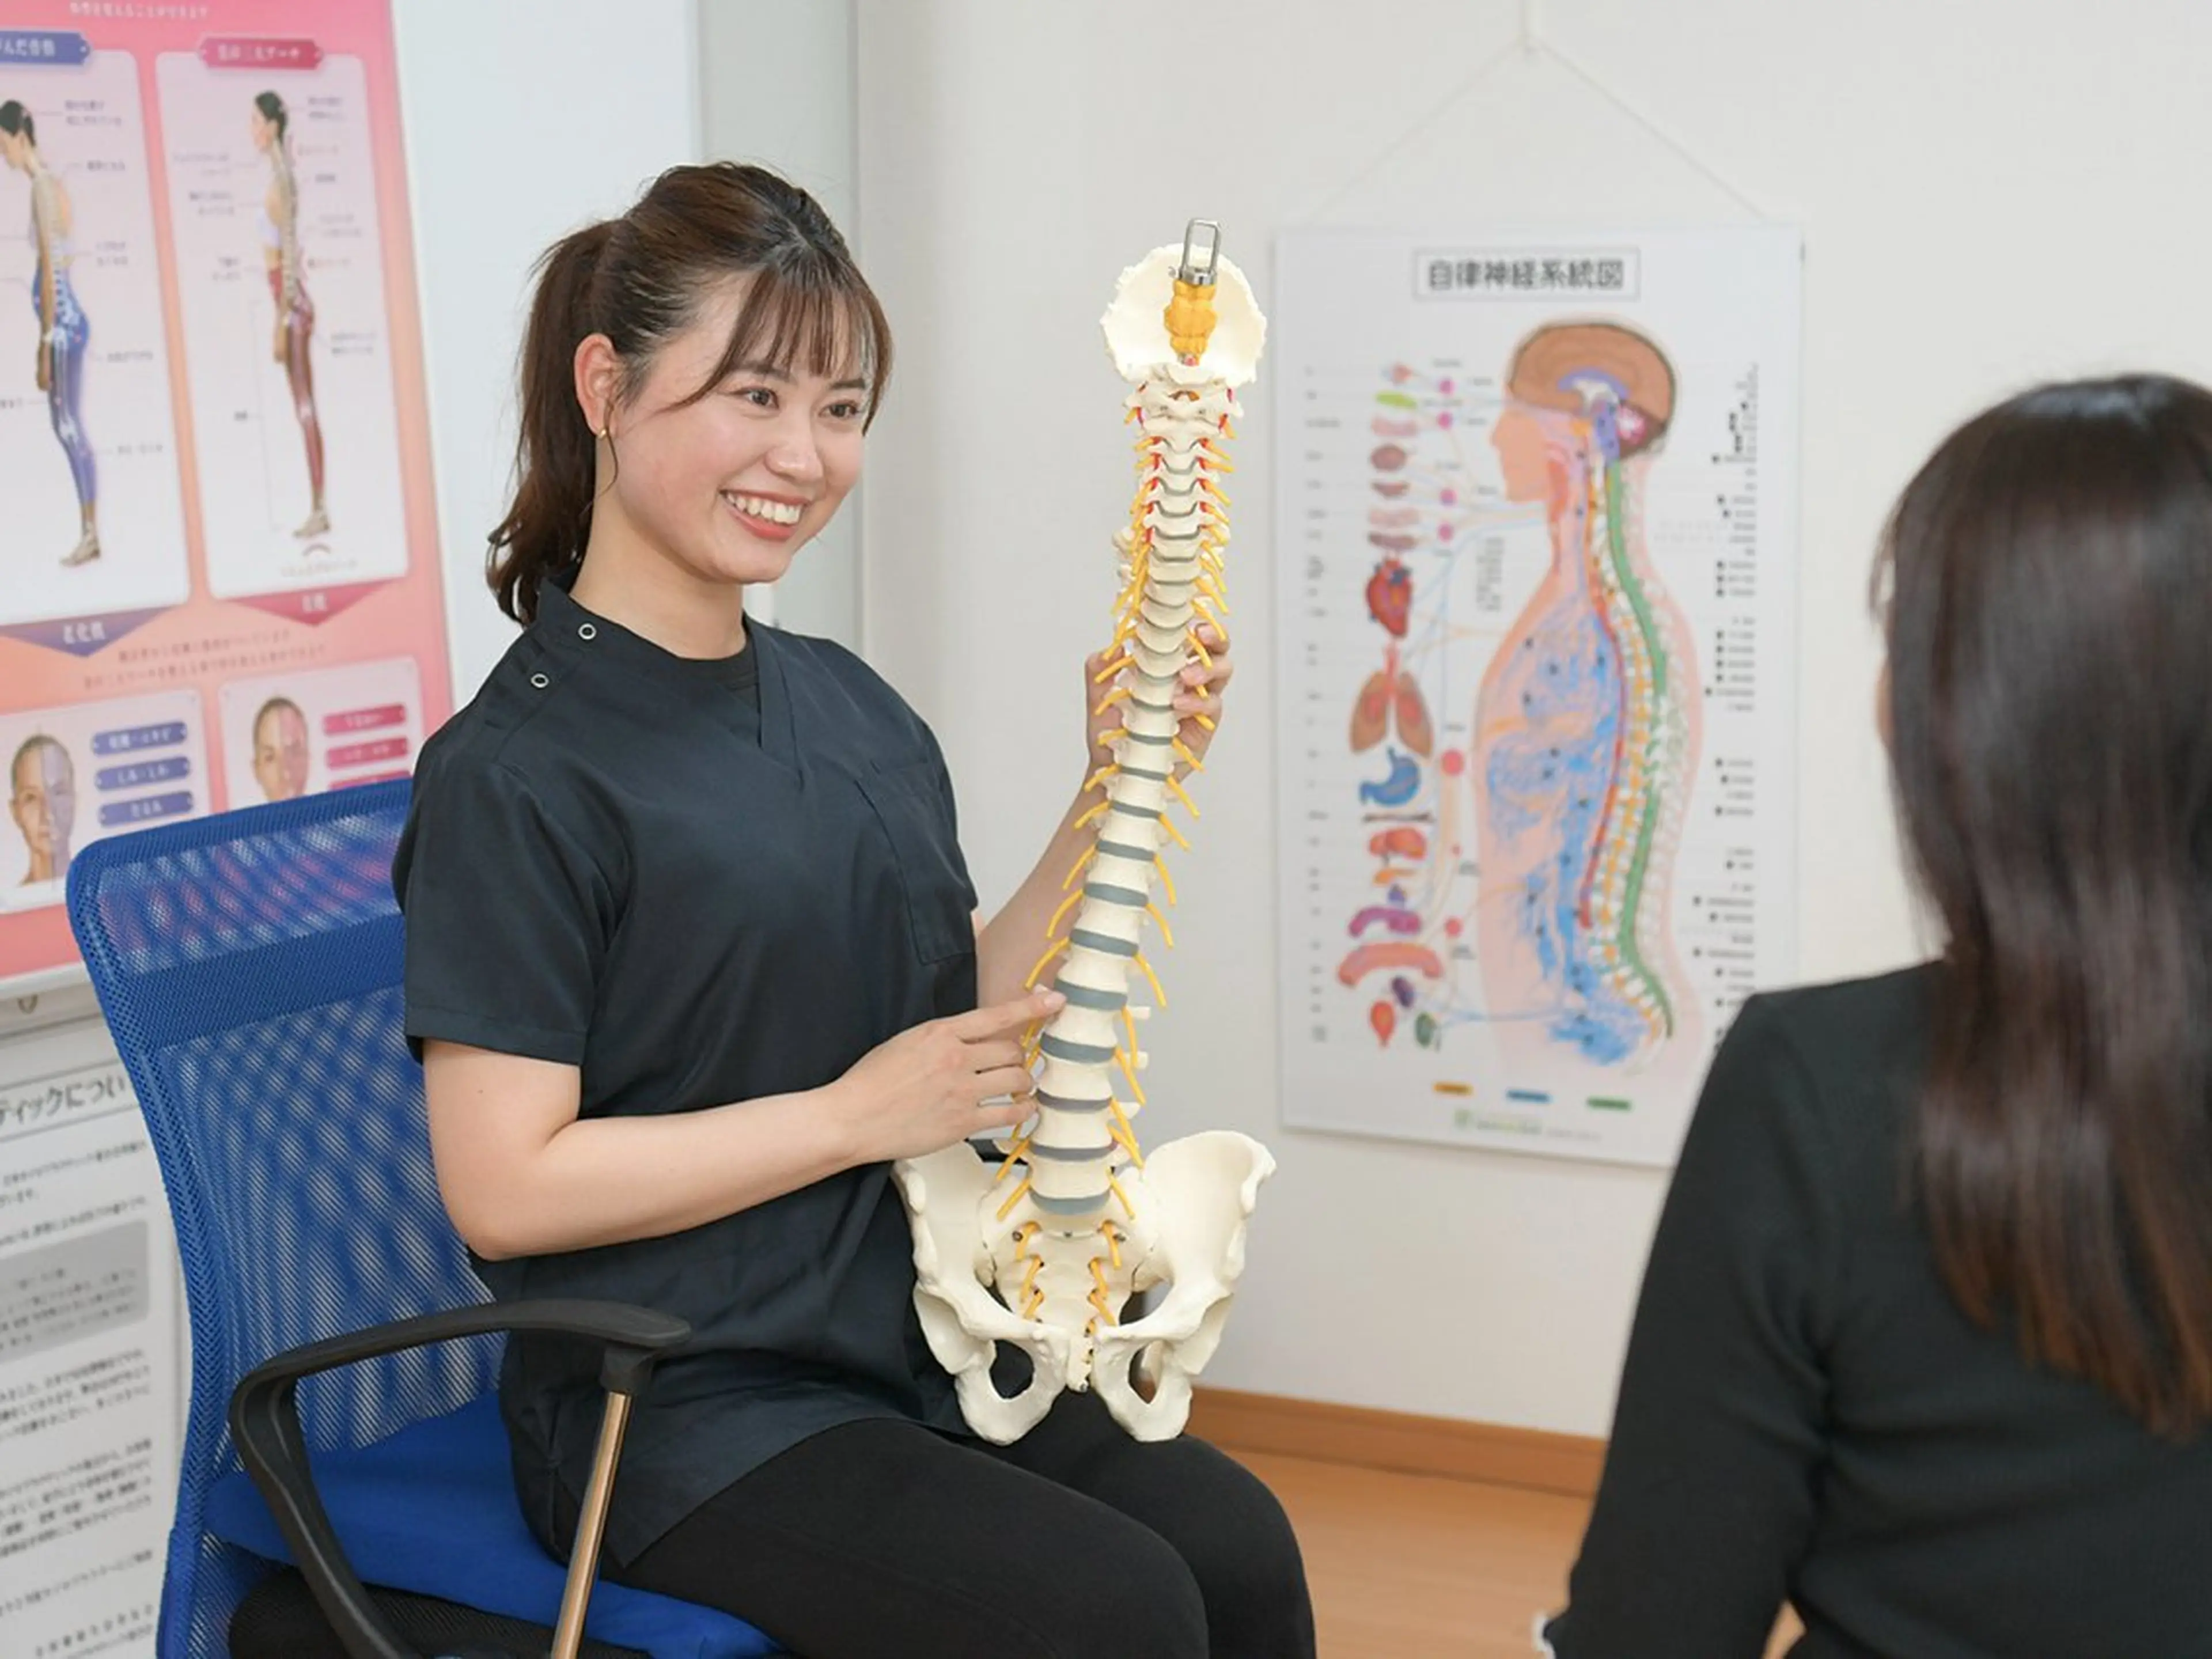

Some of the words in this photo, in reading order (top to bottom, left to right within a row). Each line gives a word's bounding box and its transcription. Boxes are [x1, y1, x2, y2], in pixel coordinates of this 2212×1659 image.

[1429, 259, 1624, 290] 自律神経系統図
